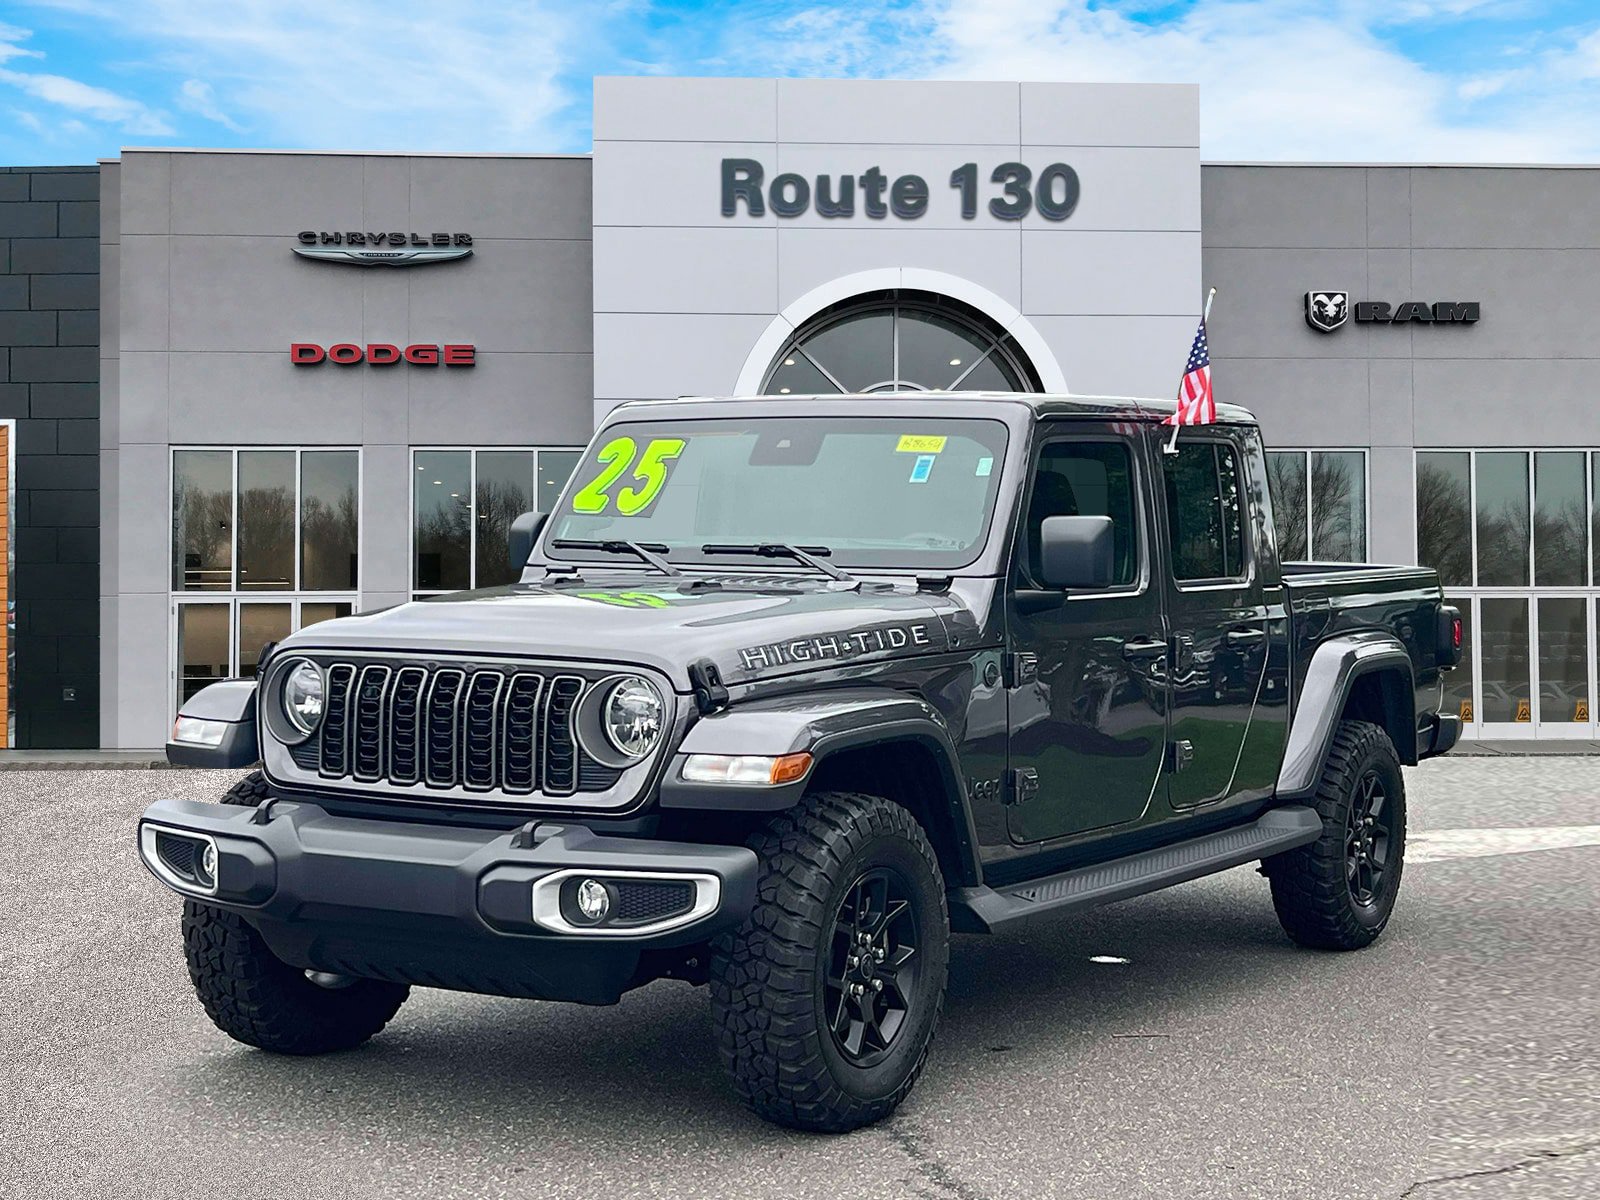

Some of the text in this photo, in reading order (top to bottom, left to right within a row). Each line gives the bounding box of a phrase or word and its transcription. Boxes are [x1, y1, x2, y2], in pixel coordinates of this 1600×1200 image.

[720, 157, 1080, 221] Route 130
[298, 231, 473, 246] CHRYSLER
[1355, 301, 1480, 324] RAM
[290, 343, 476, 366] DODGE
[572, 436, 686, 516] 25
